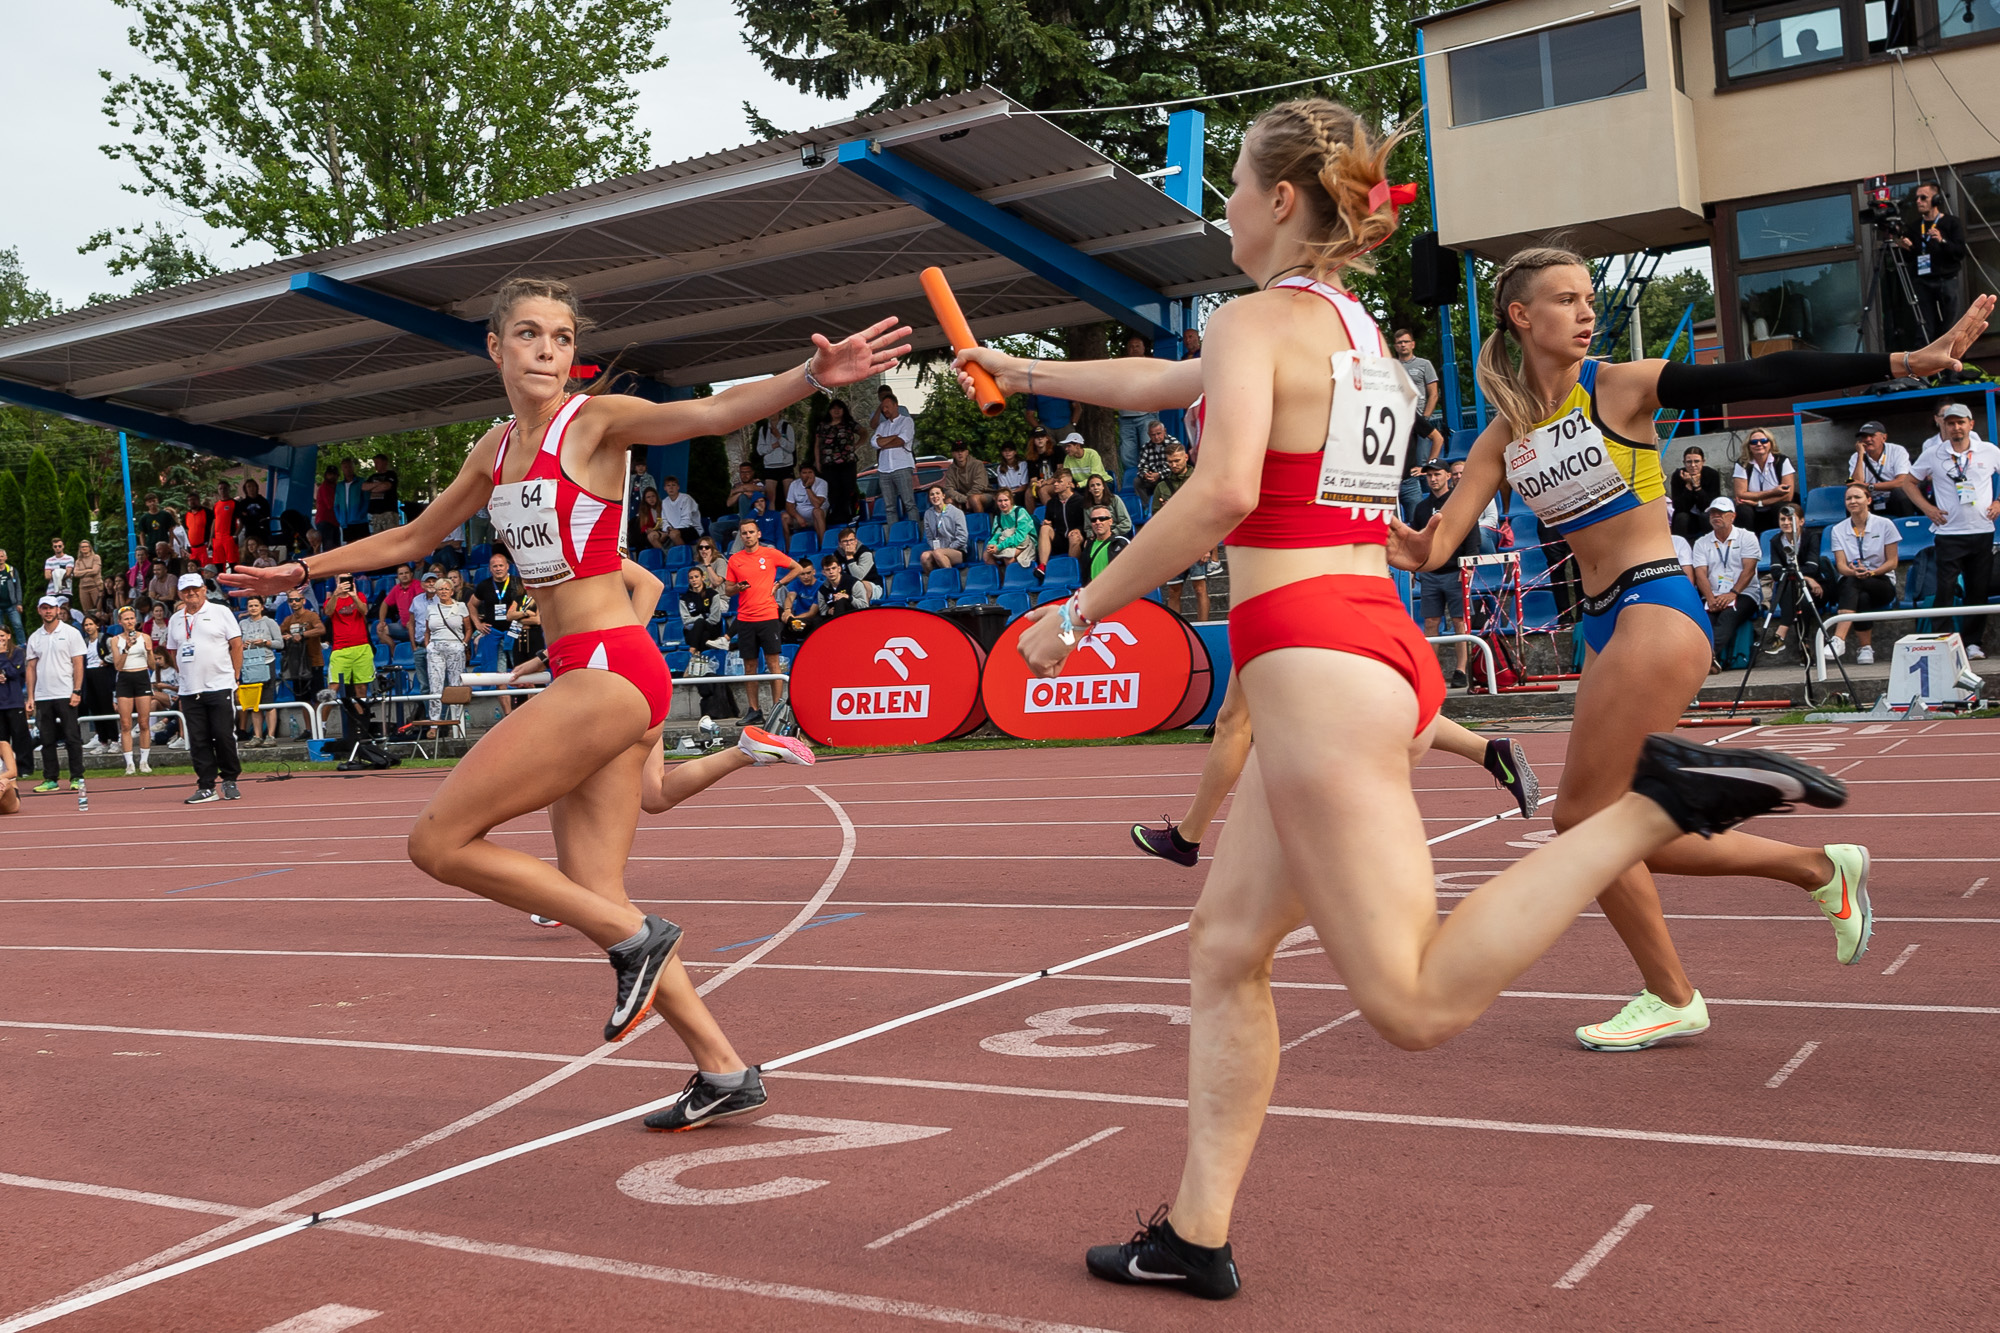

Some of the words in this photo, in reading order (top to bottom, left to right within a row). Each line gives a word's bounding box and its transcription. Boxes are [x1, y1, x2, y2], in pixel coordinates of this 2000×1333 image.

[1363, 405, 1395, 466] 62
[1547, 413, 1592, 448] 701
[1511, 449, 1536, 470] ORLEN
[1517, 446, 1602, 501] ADAMCIO
[1606, 476, 1622, 487] U18
[521, 484, 542, 508] 64
[553, 562, 567, 572] U18
[1909, 655, 1930, 697] 1
[836, 690, 923, 715] ORLEN
[1032, 679, 1131, 707] ORLEN
[616, 1113, 953, 1206] 2
